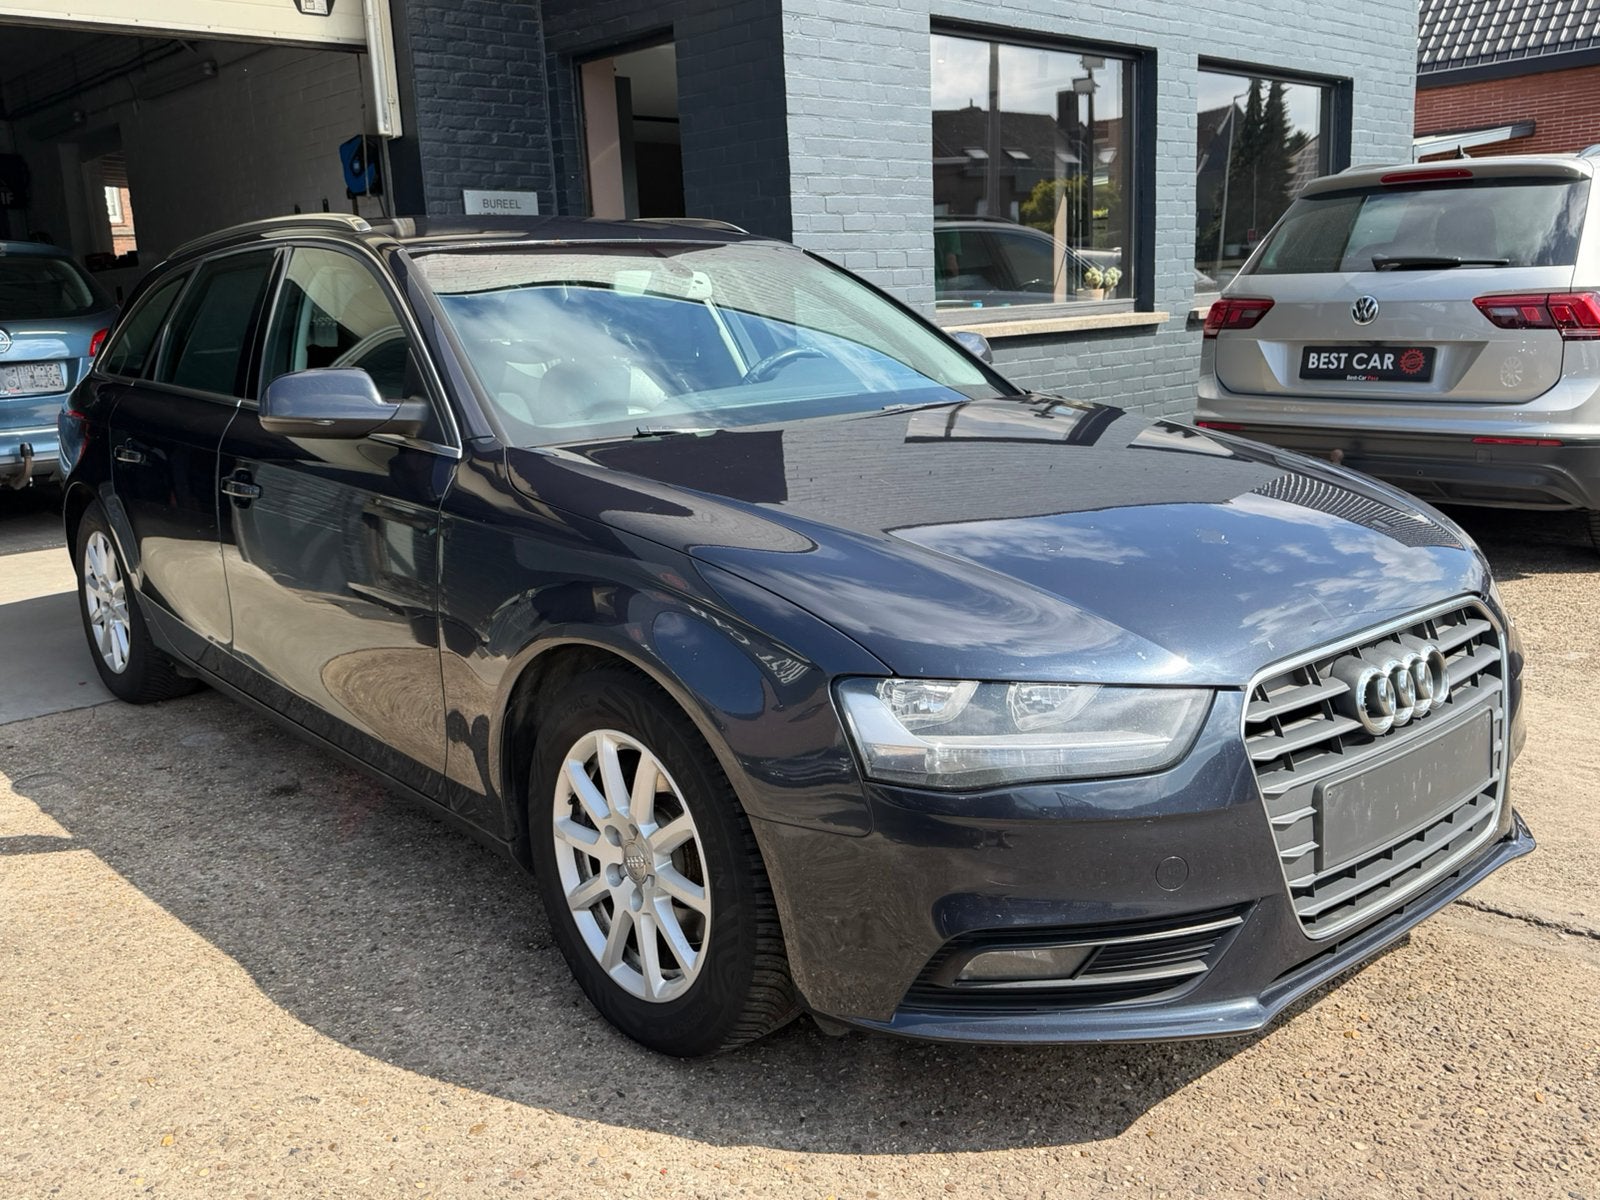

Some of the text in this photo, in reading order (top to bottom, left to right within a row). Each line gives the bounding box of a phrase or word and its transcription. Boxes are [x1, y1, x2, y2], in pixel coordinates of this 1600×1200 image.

[482, 198, 522, 209] BUREEL
[1307, 352, 1349, 370] BEST
[1352, 352, 1395, 370] CAR
